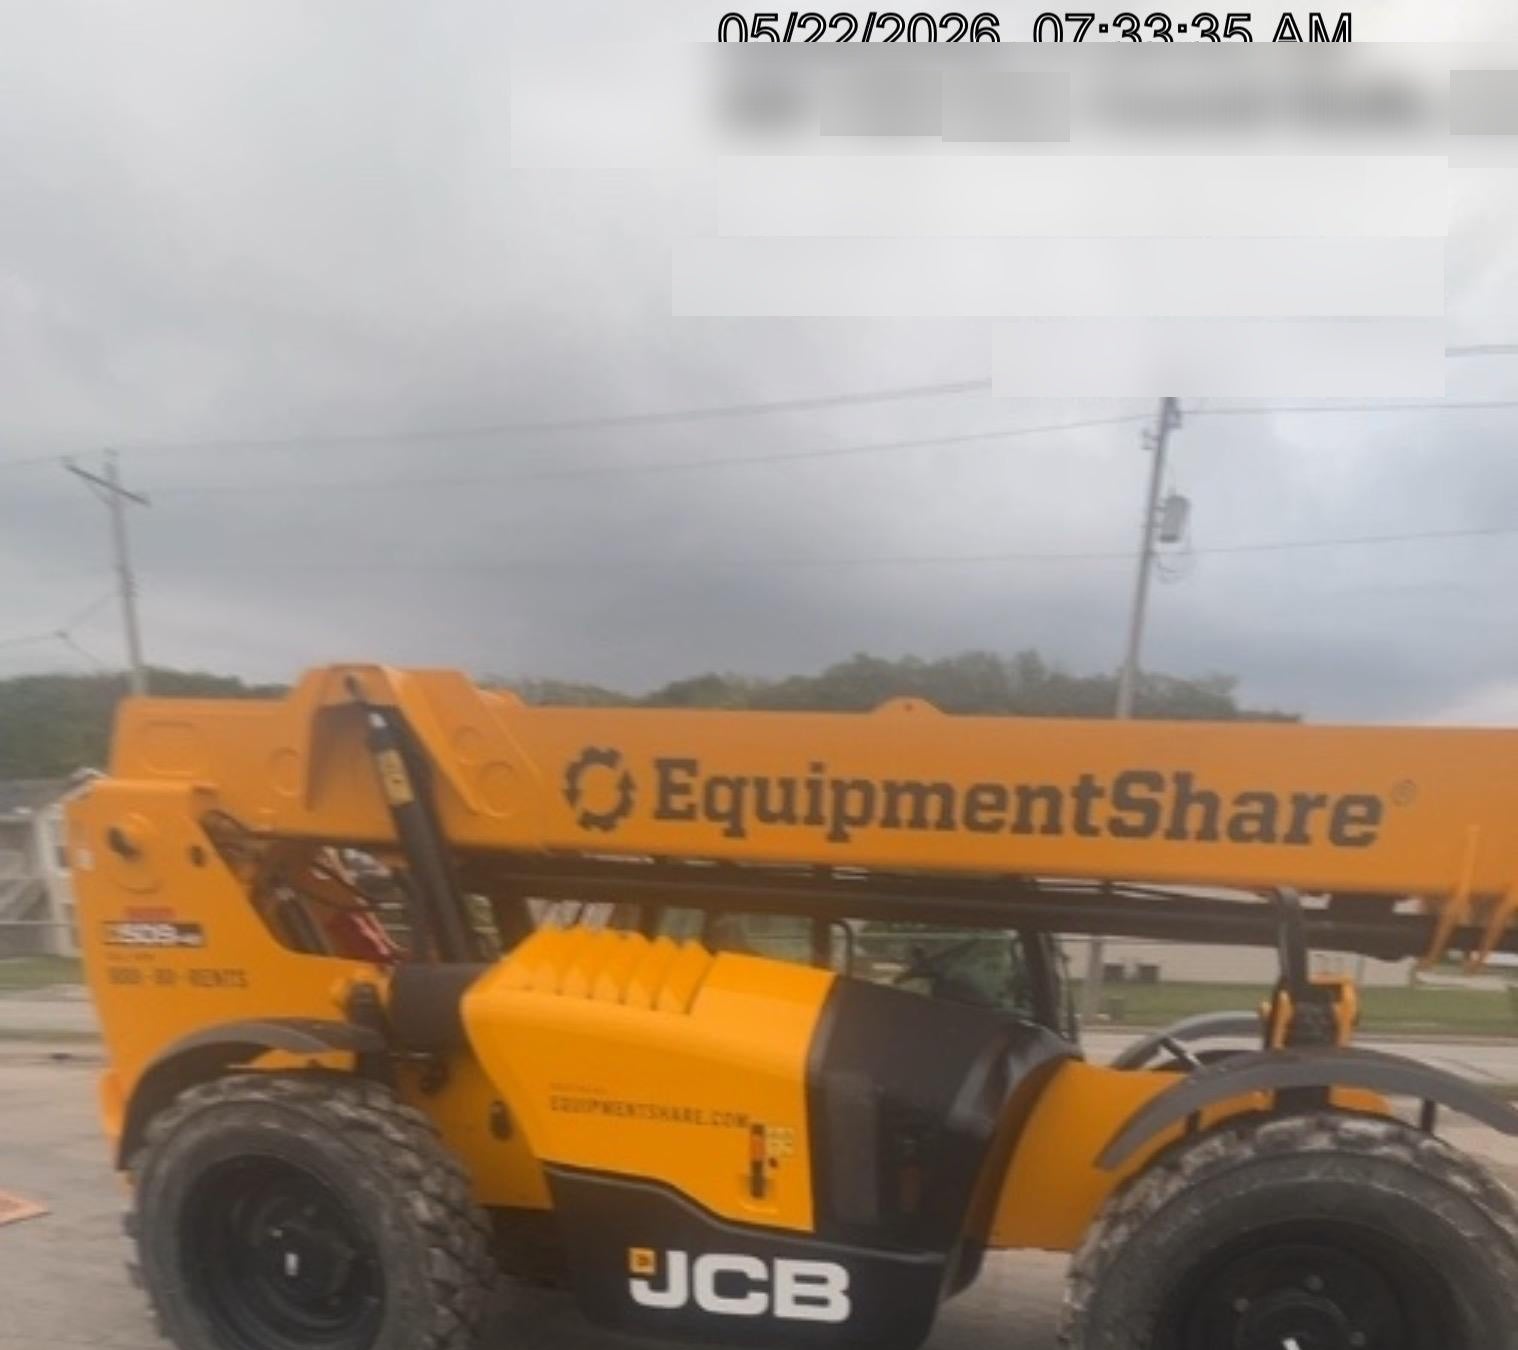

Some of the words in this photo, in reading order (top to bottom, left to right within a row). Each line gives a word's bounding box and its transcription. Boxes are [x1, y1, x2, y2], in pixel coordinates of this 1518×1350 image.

[652, 757, 1384, 848] EquipmentShare
[549, 1094, 751, 1128] EQUIPMENTSHARE.COM
[628, 1249, 851, 1323] JCB
